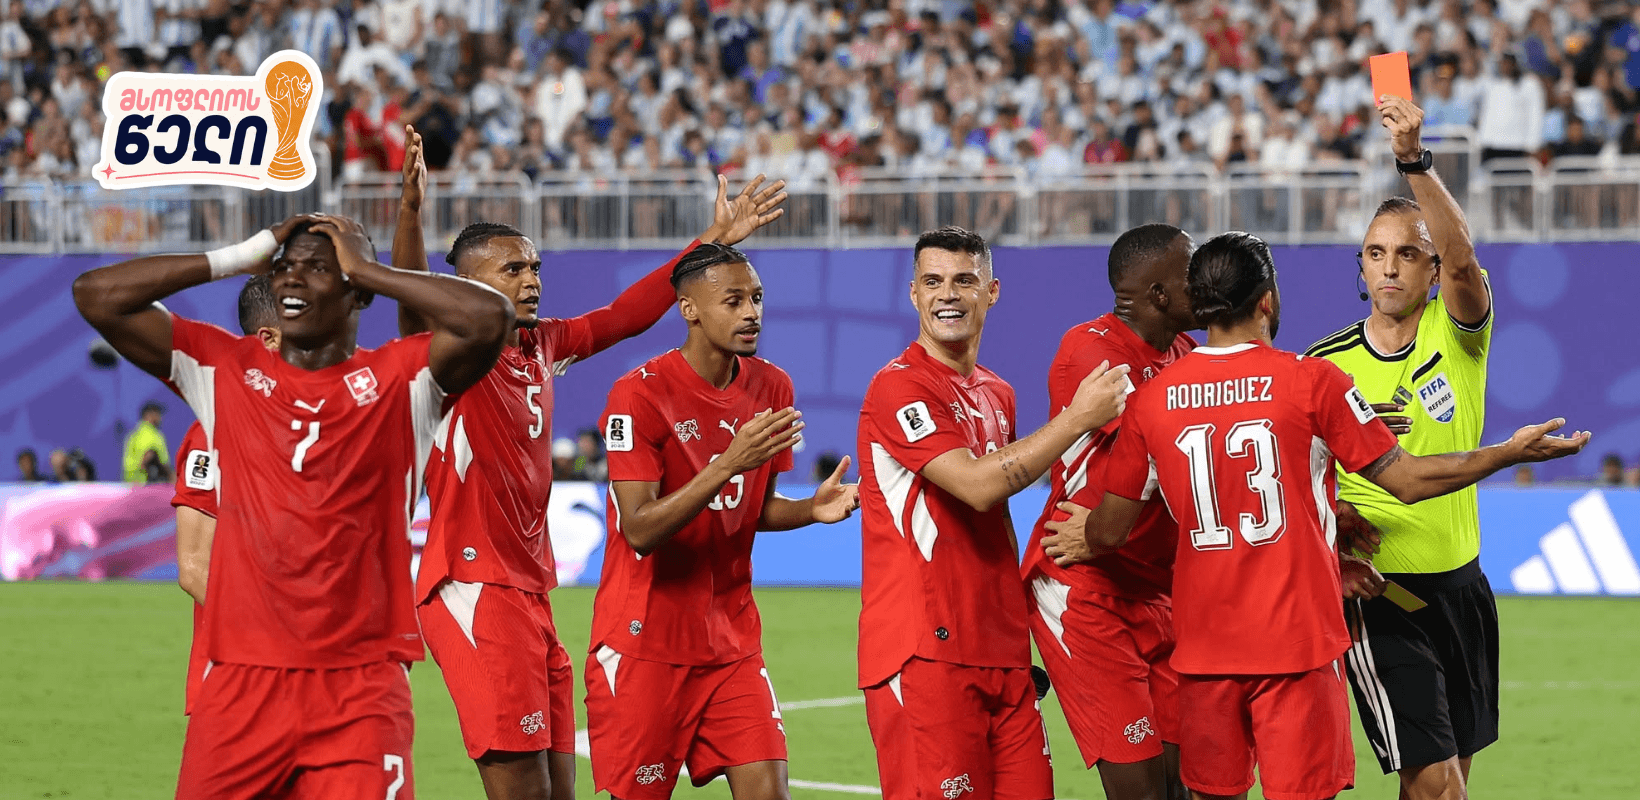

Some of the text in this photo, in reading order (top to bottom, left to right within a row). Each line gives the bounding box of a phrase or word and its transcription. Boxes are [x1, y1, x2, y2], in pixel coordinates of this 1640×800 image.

[526, 385, 543, 439] 5
[1166, 376, 1273, 411] RODRIGUEZ
[1419, 377, 1447, 401] FIFA
[1427, 391, 1453, 413] REFEREE
[291, 419, 321, 473] 7
[1174, 418, 1288, 552] 13
[383, 754, 405, 800] 7
